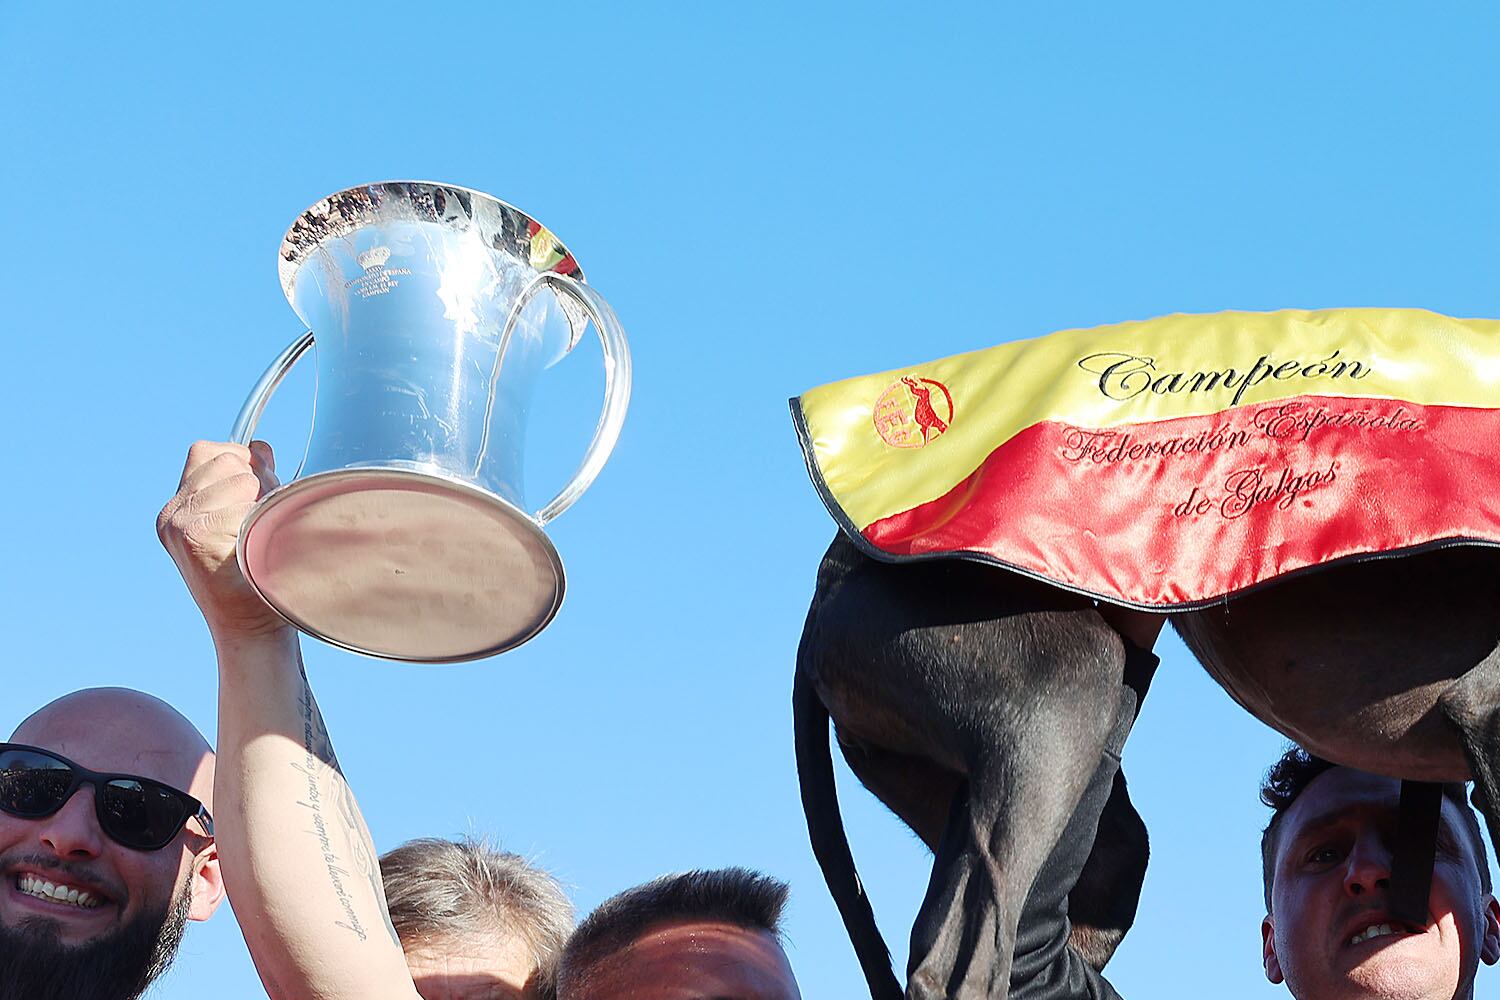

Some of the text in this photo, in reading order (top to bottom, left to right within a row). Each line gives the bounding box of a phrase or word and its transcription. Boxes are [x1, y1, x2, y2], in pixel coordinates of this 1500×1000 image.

[1078, 350, 1371, 407] Campeón
[1062, 402, 1423, 465] Federación Española
[1174, 461, 1340, 520] de Galgos
